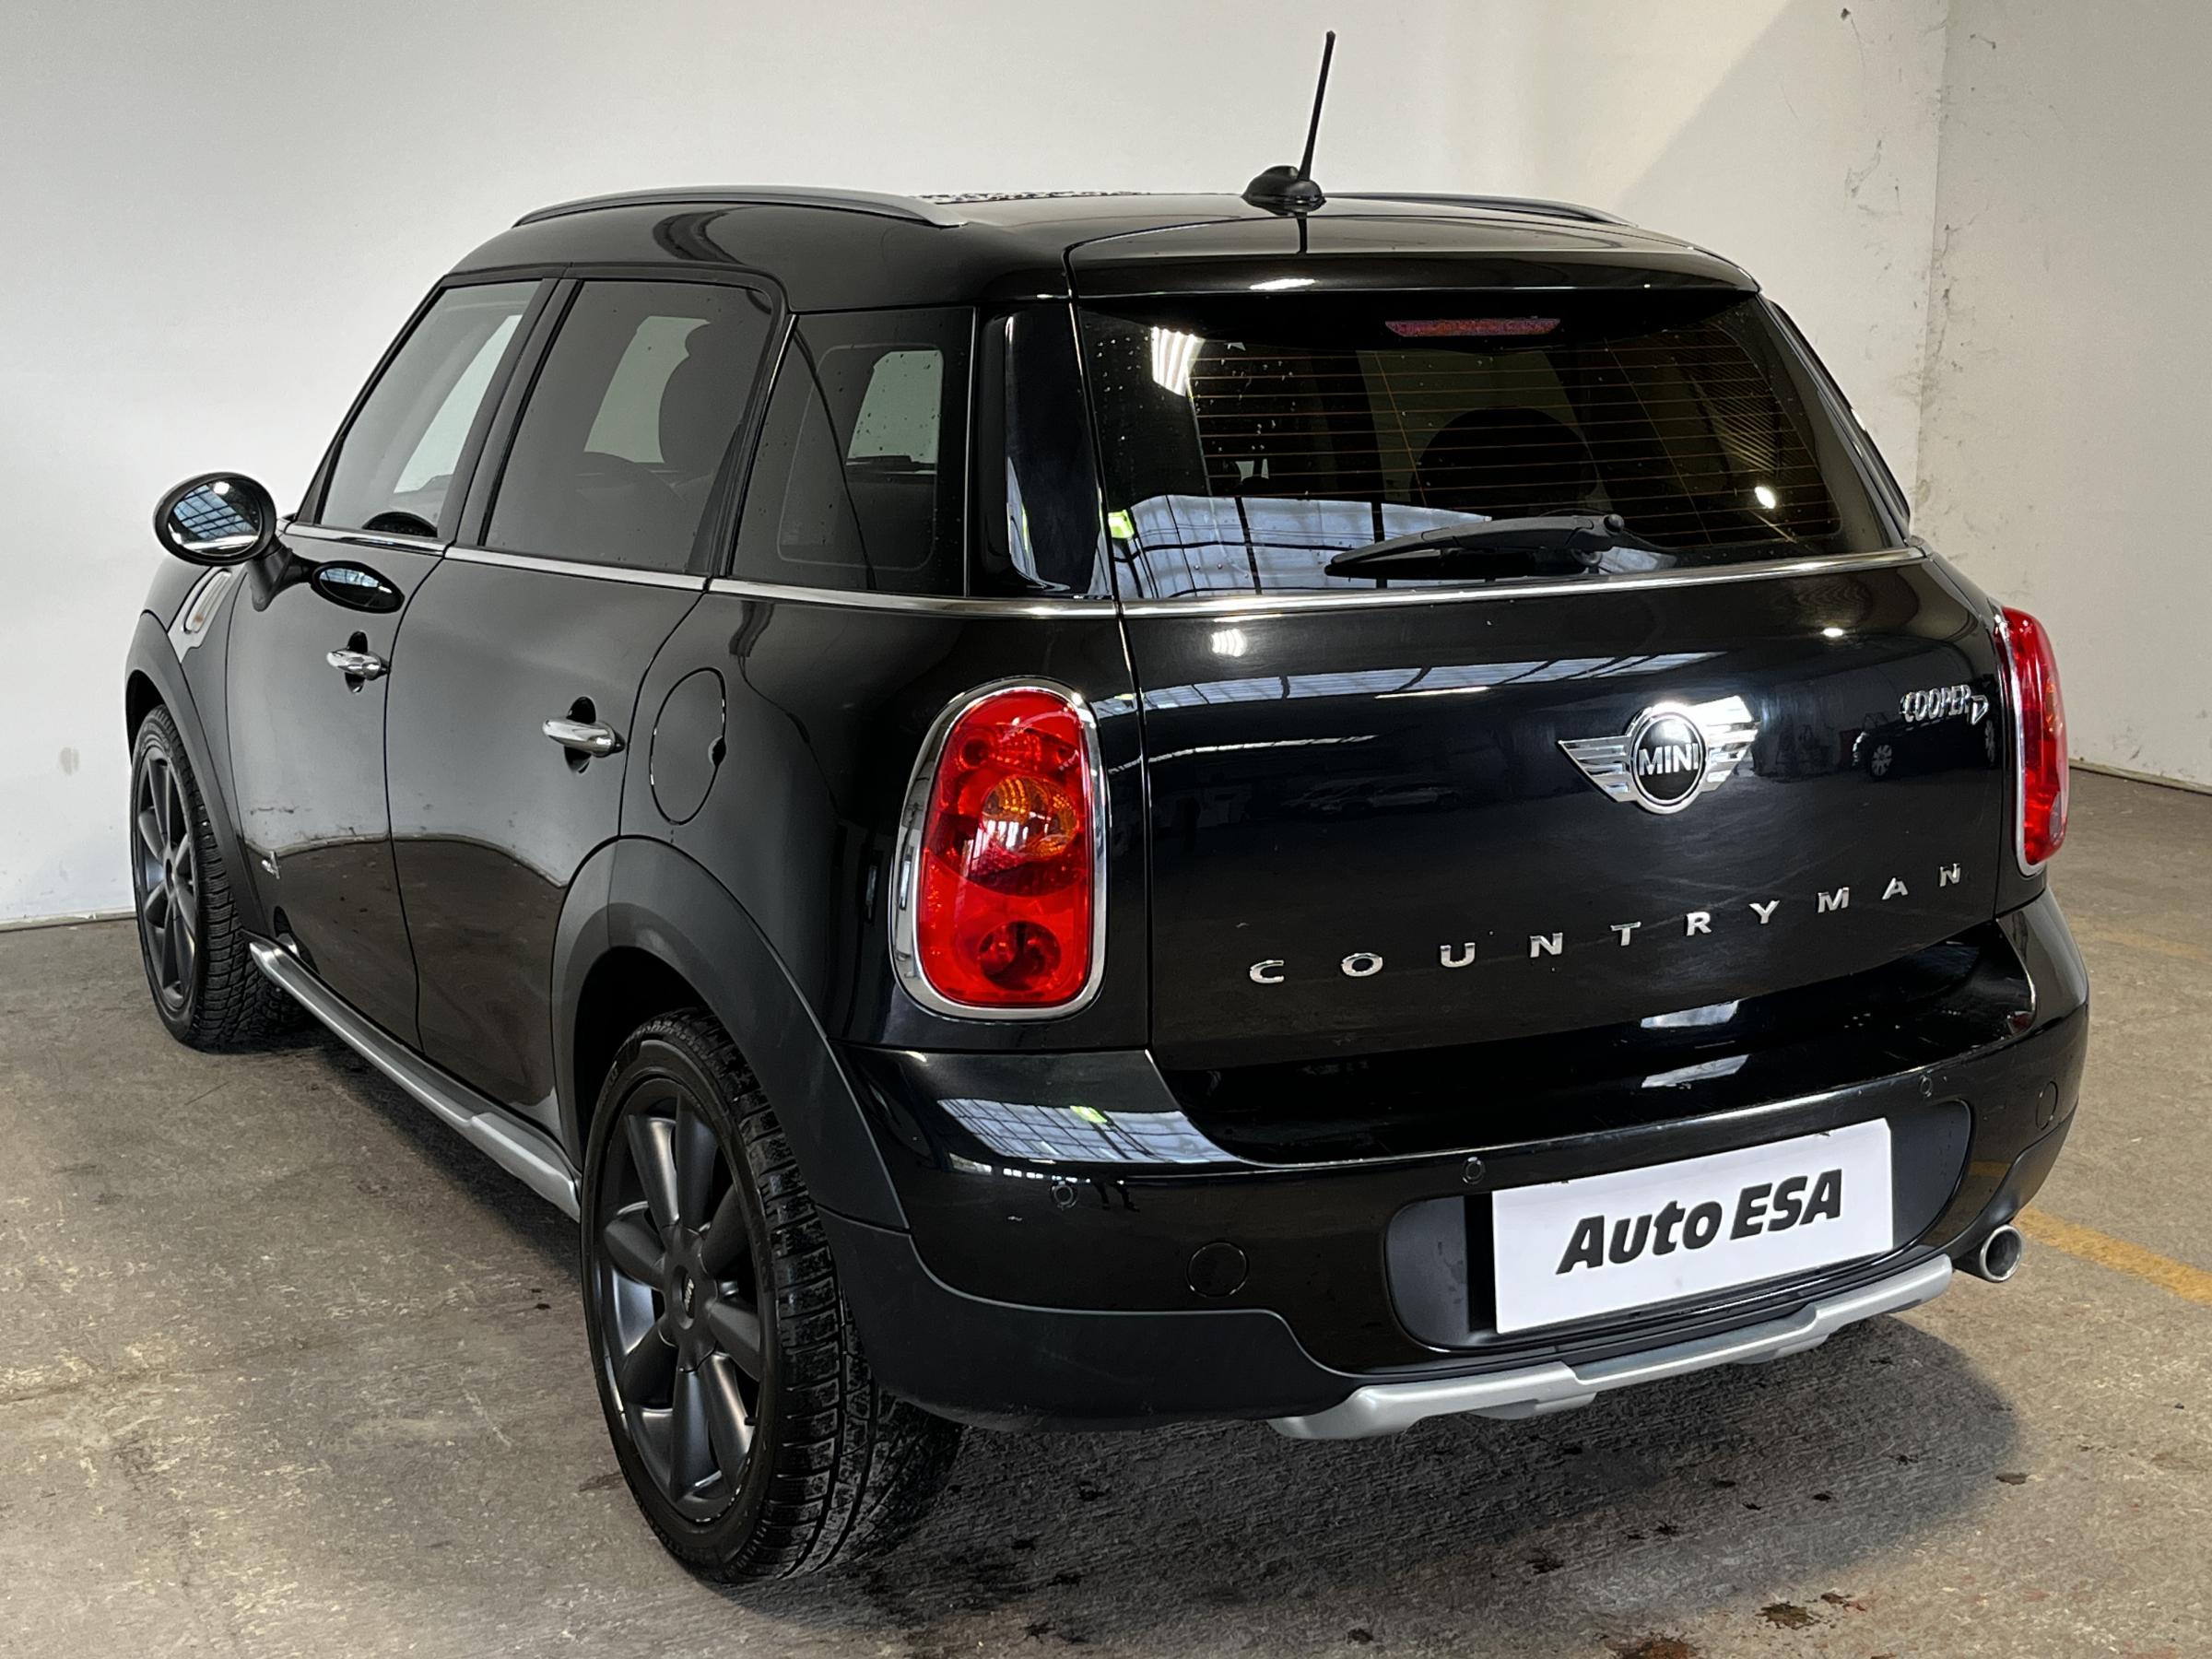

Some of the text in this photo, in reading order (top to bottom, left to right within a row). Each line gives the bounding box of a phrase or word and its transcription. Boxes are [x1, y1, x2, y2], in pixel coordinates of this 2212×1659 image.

[1900, 684, 1989, 725] COOPER D
[1639, 742, 1699, 776] MINI
[1249, 863, 1961, 984] COUNTRYMAN
[1555, 1169, 1842, 1275] Auto ESA
